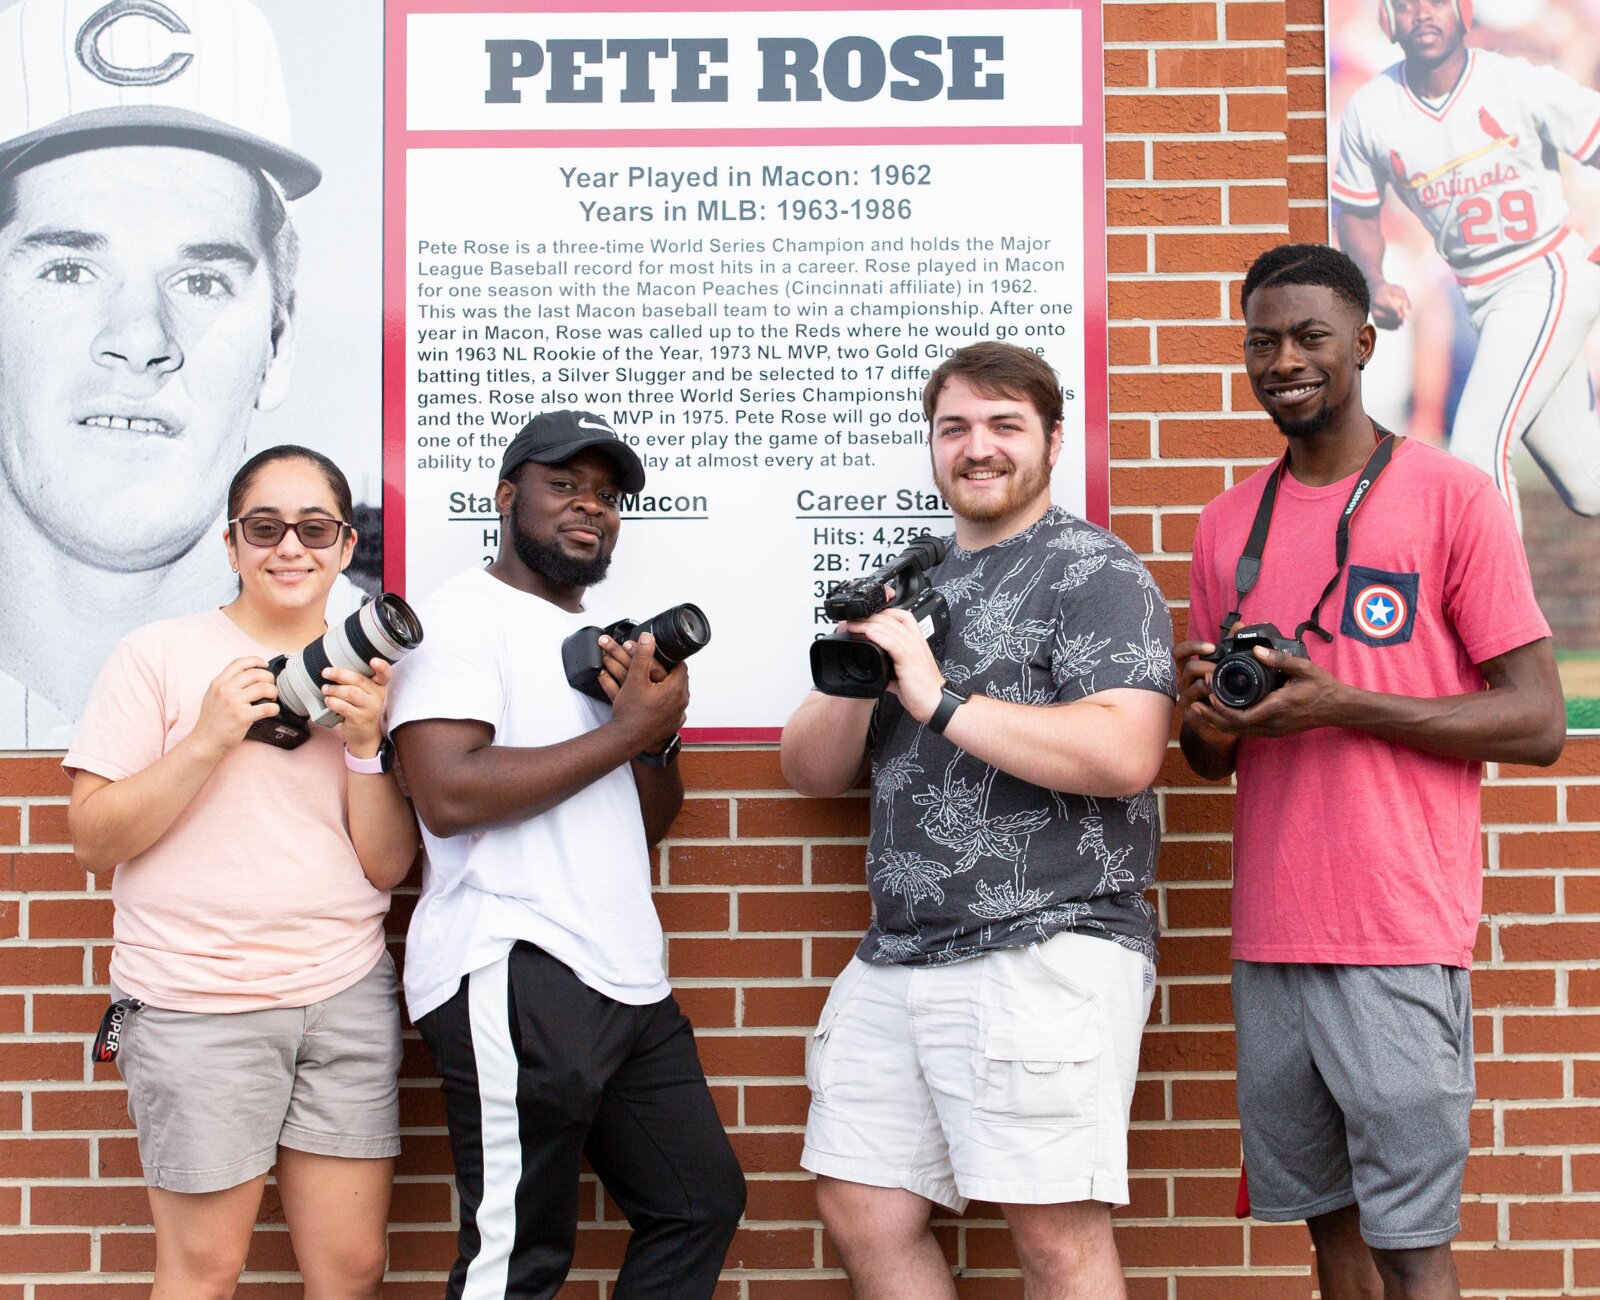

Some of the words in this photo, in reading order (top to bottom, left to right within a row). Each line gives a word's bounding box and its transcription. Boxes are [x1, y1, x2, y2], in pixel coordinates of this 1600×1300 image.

[485, 38, 728, 103] PETE
[757, 36, 1004, 101] ROSE
[560, 167, 619, 188] Year
[629, 166, 717, 191] Played
[729, 166, 750, 186] in
[763, 166, 858, 186] Macon:
[871, 165, 930, 185] 1962
[1411, 163, 1520, 207] Cardinals
[579, 201, 653, 222] Years
[665, 201, 686, 221] in
[698, 200, 765, 221] MLB:
[778, 199, 911, 220] 1963-1986
[1457, 189, 1537, 245] 29
[419, 241, 457, 254] Pete
[465, 240, 509, 254] Rose
[517, 240, 529, 253] is
[537, 244, 545, 253] a
[553, 240, 643, 253] three-time
[651, 239, 702, 253] World
[710, 239, 765, 252] Series
[773, 238, 863, 255] Champion
[871, 237, 903, 251] and
[911, 237, 959, 251] holds
[967, 237, 993, 250] the
[1002, 237, 1050, 254] Major
[419, 262, 483, 279] League
[491, 261, 567, 275] Baseball
[575, 261, 631, 275] record
[639, 261, 663, 274] for
[670, 262, 714, 274] most
[721, 260, 752, 273] hits
[761, 260, 775, 273] in
[783, 263, 791, 273] a
[799, 263, 858, 273] career.
[866, 259, 910, 272] Rose
[918, 258, 976, 276] played
[984, 258, 998, 271] in
[1006, 258, 1064, 271] Macon
[418, 283, 442, 297] for
[449, 287, 481, 297] one
[488, 286, 552, 296] season
[559, 283, 595, 296] with
[603, 282, 629, 296] the
[638, 282, 695, 295] Macon
[704, 282, 778, 295] Peaches
[786, 280, 882, 298] (Cincinnati
[890, 280, 961, 297] affiliate)
[969, 280, 983, 293] in
[992, 279, 1036, 293] 1962.
[418, 305, 455, 318] This
[463, 308, 497, 318] was
[504, 304, 531, 318] the
[539, 304, 570, 318] last
[577, 304, 635, 317] Macon
[643, 303, 716, 317] baseball
[724, 304, 766, 316] team
[774, 304, 790, 316] to
[797, 302, 827, 316] win
[835, 306, 843, 316] a
[851, 301, 983, 319] championship.
[990, 301, 1034, 314] After
[1040, 304, 1072, 314] one
[418, 330, 456, 344] year
[463, 327, 477, 339] in
[486, 326, 548, 341] Macon,
[557, 326, 601, 339] Rose
[608, 328, 642, 339] was
[650, 325, 701, 338] called
[710, 328, 731, 341] up
[738, 326, 754, 338] to
[761, 324, 788, 338] the
[796, 324, 840, 337] Reds
[847, 324, 901, 337] where
[909, 323, 928, 336] he
[935, 323, 989, 336] would
[996, 326, 1018, 340] go
[1025, 323, 1065, 336] onto
[418, 347, 448, 361] win
[456, 347, 496, 361] 1963
[504, 347, 527, 361] NL
[534, 347, 595, 361] Rookie
[603, 346, 620, 360] of
[625, 346, 653, 360] the
[660, 346, 702, 362] Year,
[710, 346, 750, 359] 1973
[758, 345, 781, 359] NL
[789, 345, 830, 361] MVP,
[837, 346, 869, 359] two
[876, 344, 917, 358] Gold
[418, 369, 480, 386] batting
[487, 369, 535, 384] titles,
[542, 372, 551, 382] a
[558, 368, 609, 382] Silver
[616, 368, 686, 385] Slugger
[692, 367, 724, 381] and
[732, 367, 752, 381] be
[760, 366, 834, 381] selected
[841, 368, 857, 380] to
[865, 366, 884, 380] 17
[891, 366, 931, 380] diffe
[418, 394, 482, 408] games.
[490, 390, 534, 404] Rose
[541, 389, 578, 403] also
[585, 393, 621, 403] won
[628, 389, 673, 403] three
[680, 389, 732, 402] World
[740, 388, 795, 402] Series
[803, 387, 923, 405] Championshi
[418, 412, 450, 426] and
[457, 412, 484, 425] the
[491, 411, 541, 425] Worl
[613, 411, 653, 425] MVP
[660, 410, 675, 424] in
[683, 410, 728, 424] 1975.
[736, 410, 774, 424] Pete
[782, 410, 826, 423] Rose
[833, 409, 862, 423] will
[870, 412, 891, 427] go
[418, 437, 450, 447] one
[457, 433, 475, 447] of
[480, 433, 507, 447] the
[623, 434, 640, 446] to
[647, 435, 685, 446] ever
[692, 432, 728, 449] play
[735, 432, 762, 445] the
[769, 435, 817, 449] game
[825, 431, 842, 444] of
[848, 430, 928, 447] baseball,
[418, 455, 471, 472] ability
[478, 456, 495, 468] to
[644, 454, 669, 471] lay
[675, 454, 691, 467] at
[698, 453, 758, 467] almost
[765, 456, 813, 470] every
[821, 454, 836, 466] at
[843, 452, 875, 466] bat.
[620, 489, 707, 512] Macon
[797, 490, 887, 511] Career
[896, 489, 950, 511] Stat
[1345, 479, 1370, 515] Canon
[814, 528, 863, 545] Hits:
[813, 554, 849, 571] 2B:
